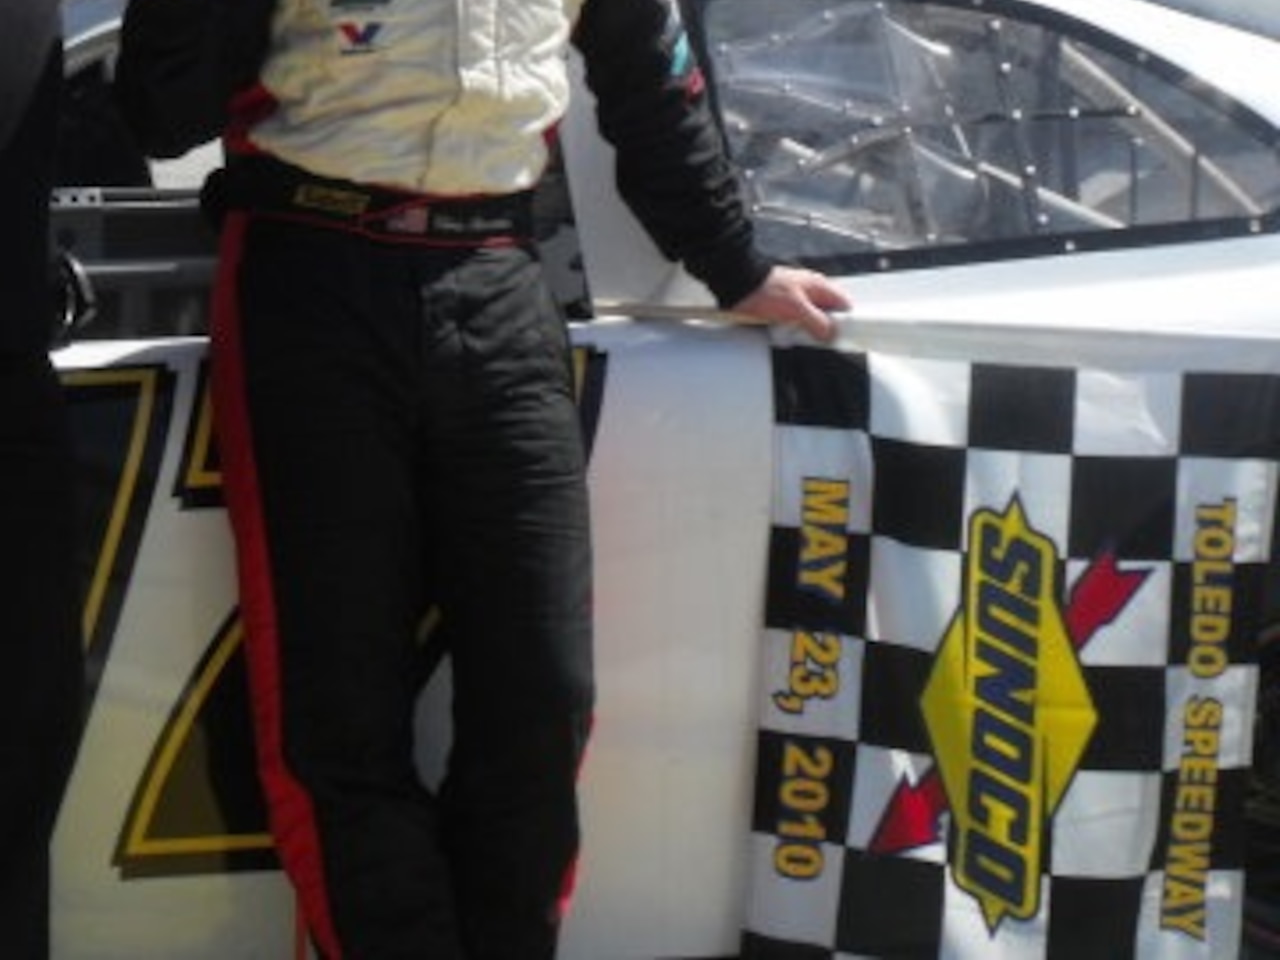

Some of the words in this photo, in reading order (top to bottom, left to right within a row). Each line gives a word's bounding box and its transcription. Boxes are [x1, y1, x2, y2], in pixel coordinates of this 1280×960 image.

[797, 476, 850, 599] MAY
[1189, 497, 1237, 680] TOLEDO
[771, 629, 842, 714] 23,
[962, 523, 1043, 905] SUNOCO
[773, 744, 834, 880] 2010
[1160, 692, 1224, 942] SPEEDWAY
